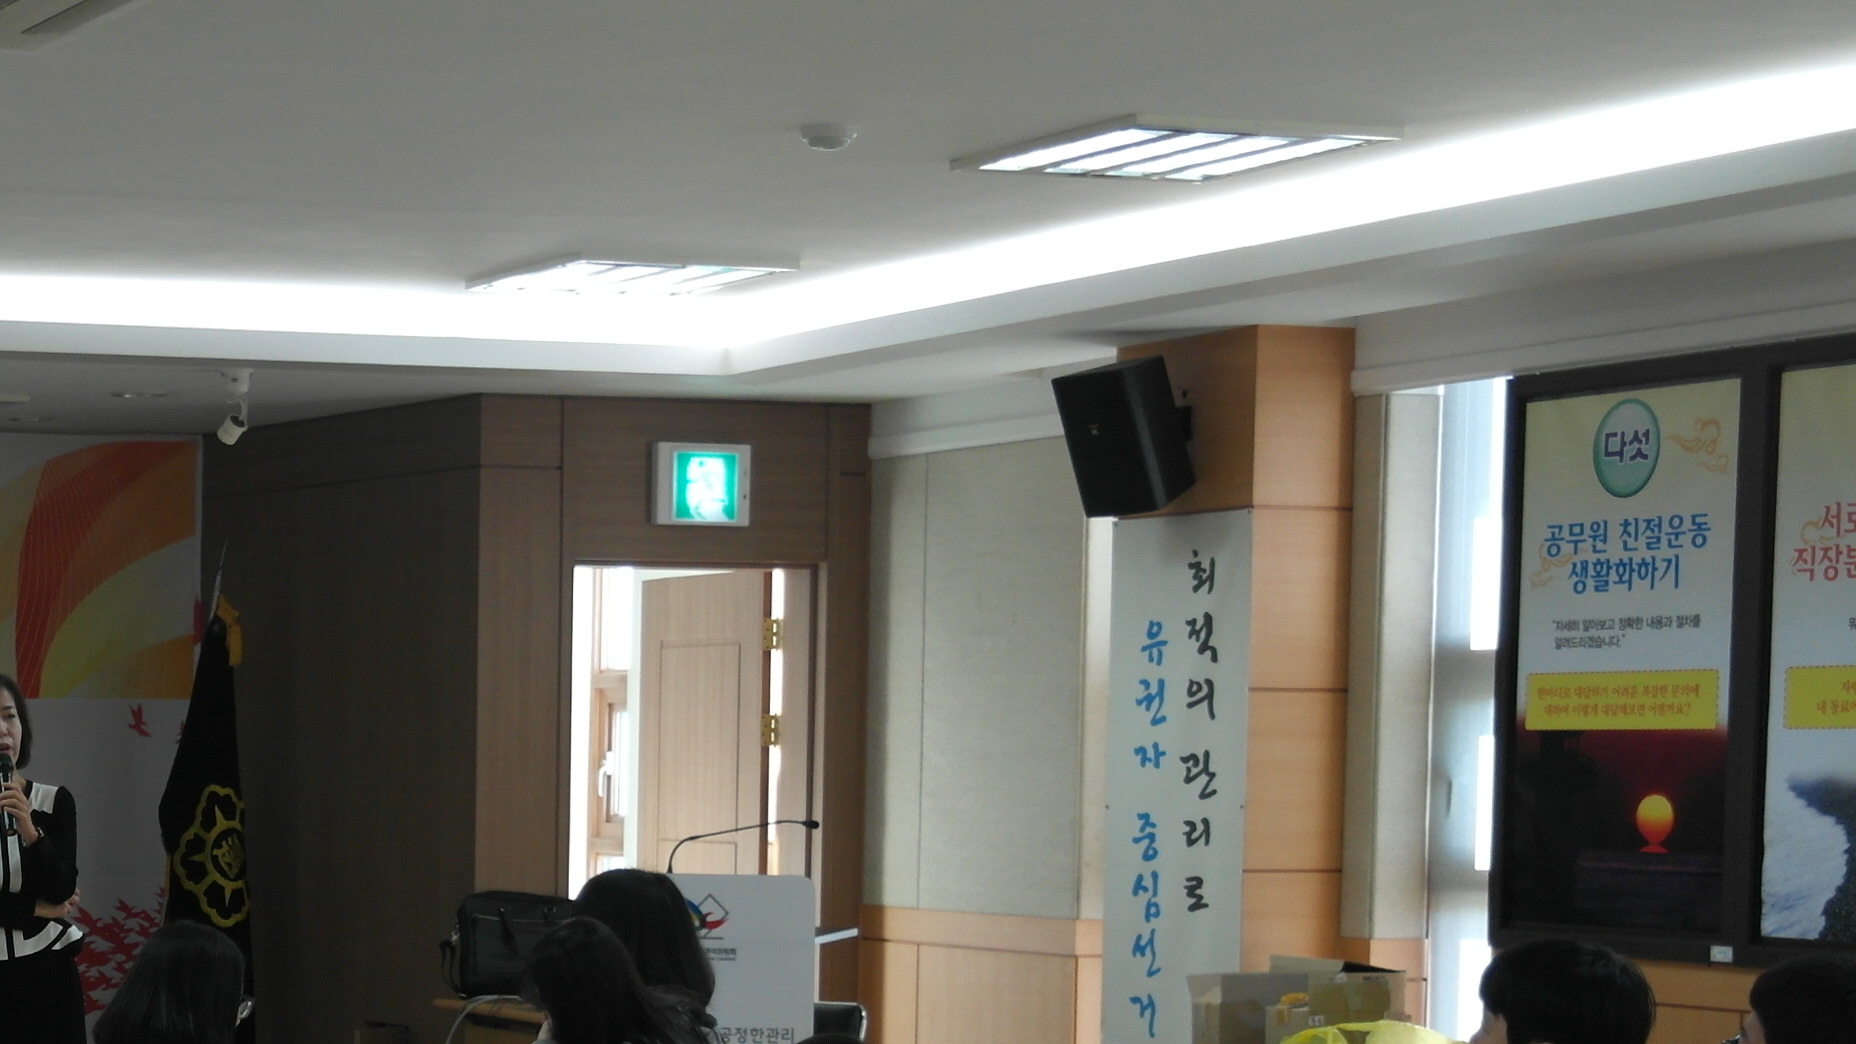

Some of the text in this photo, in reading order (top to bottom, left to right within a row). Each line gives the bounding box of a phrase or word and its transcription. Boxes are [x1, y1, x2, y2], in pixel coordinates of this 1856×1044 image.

[1603, 427, 1651, 463] 다섯
[1544, 512, 1712, 559] 공무원 친절운동
[1568, 554, 1681, 595] 생활화하기
[1133, 619, 1169, 770] 유권자
[1180, 749, 1218, 913] 관리로
